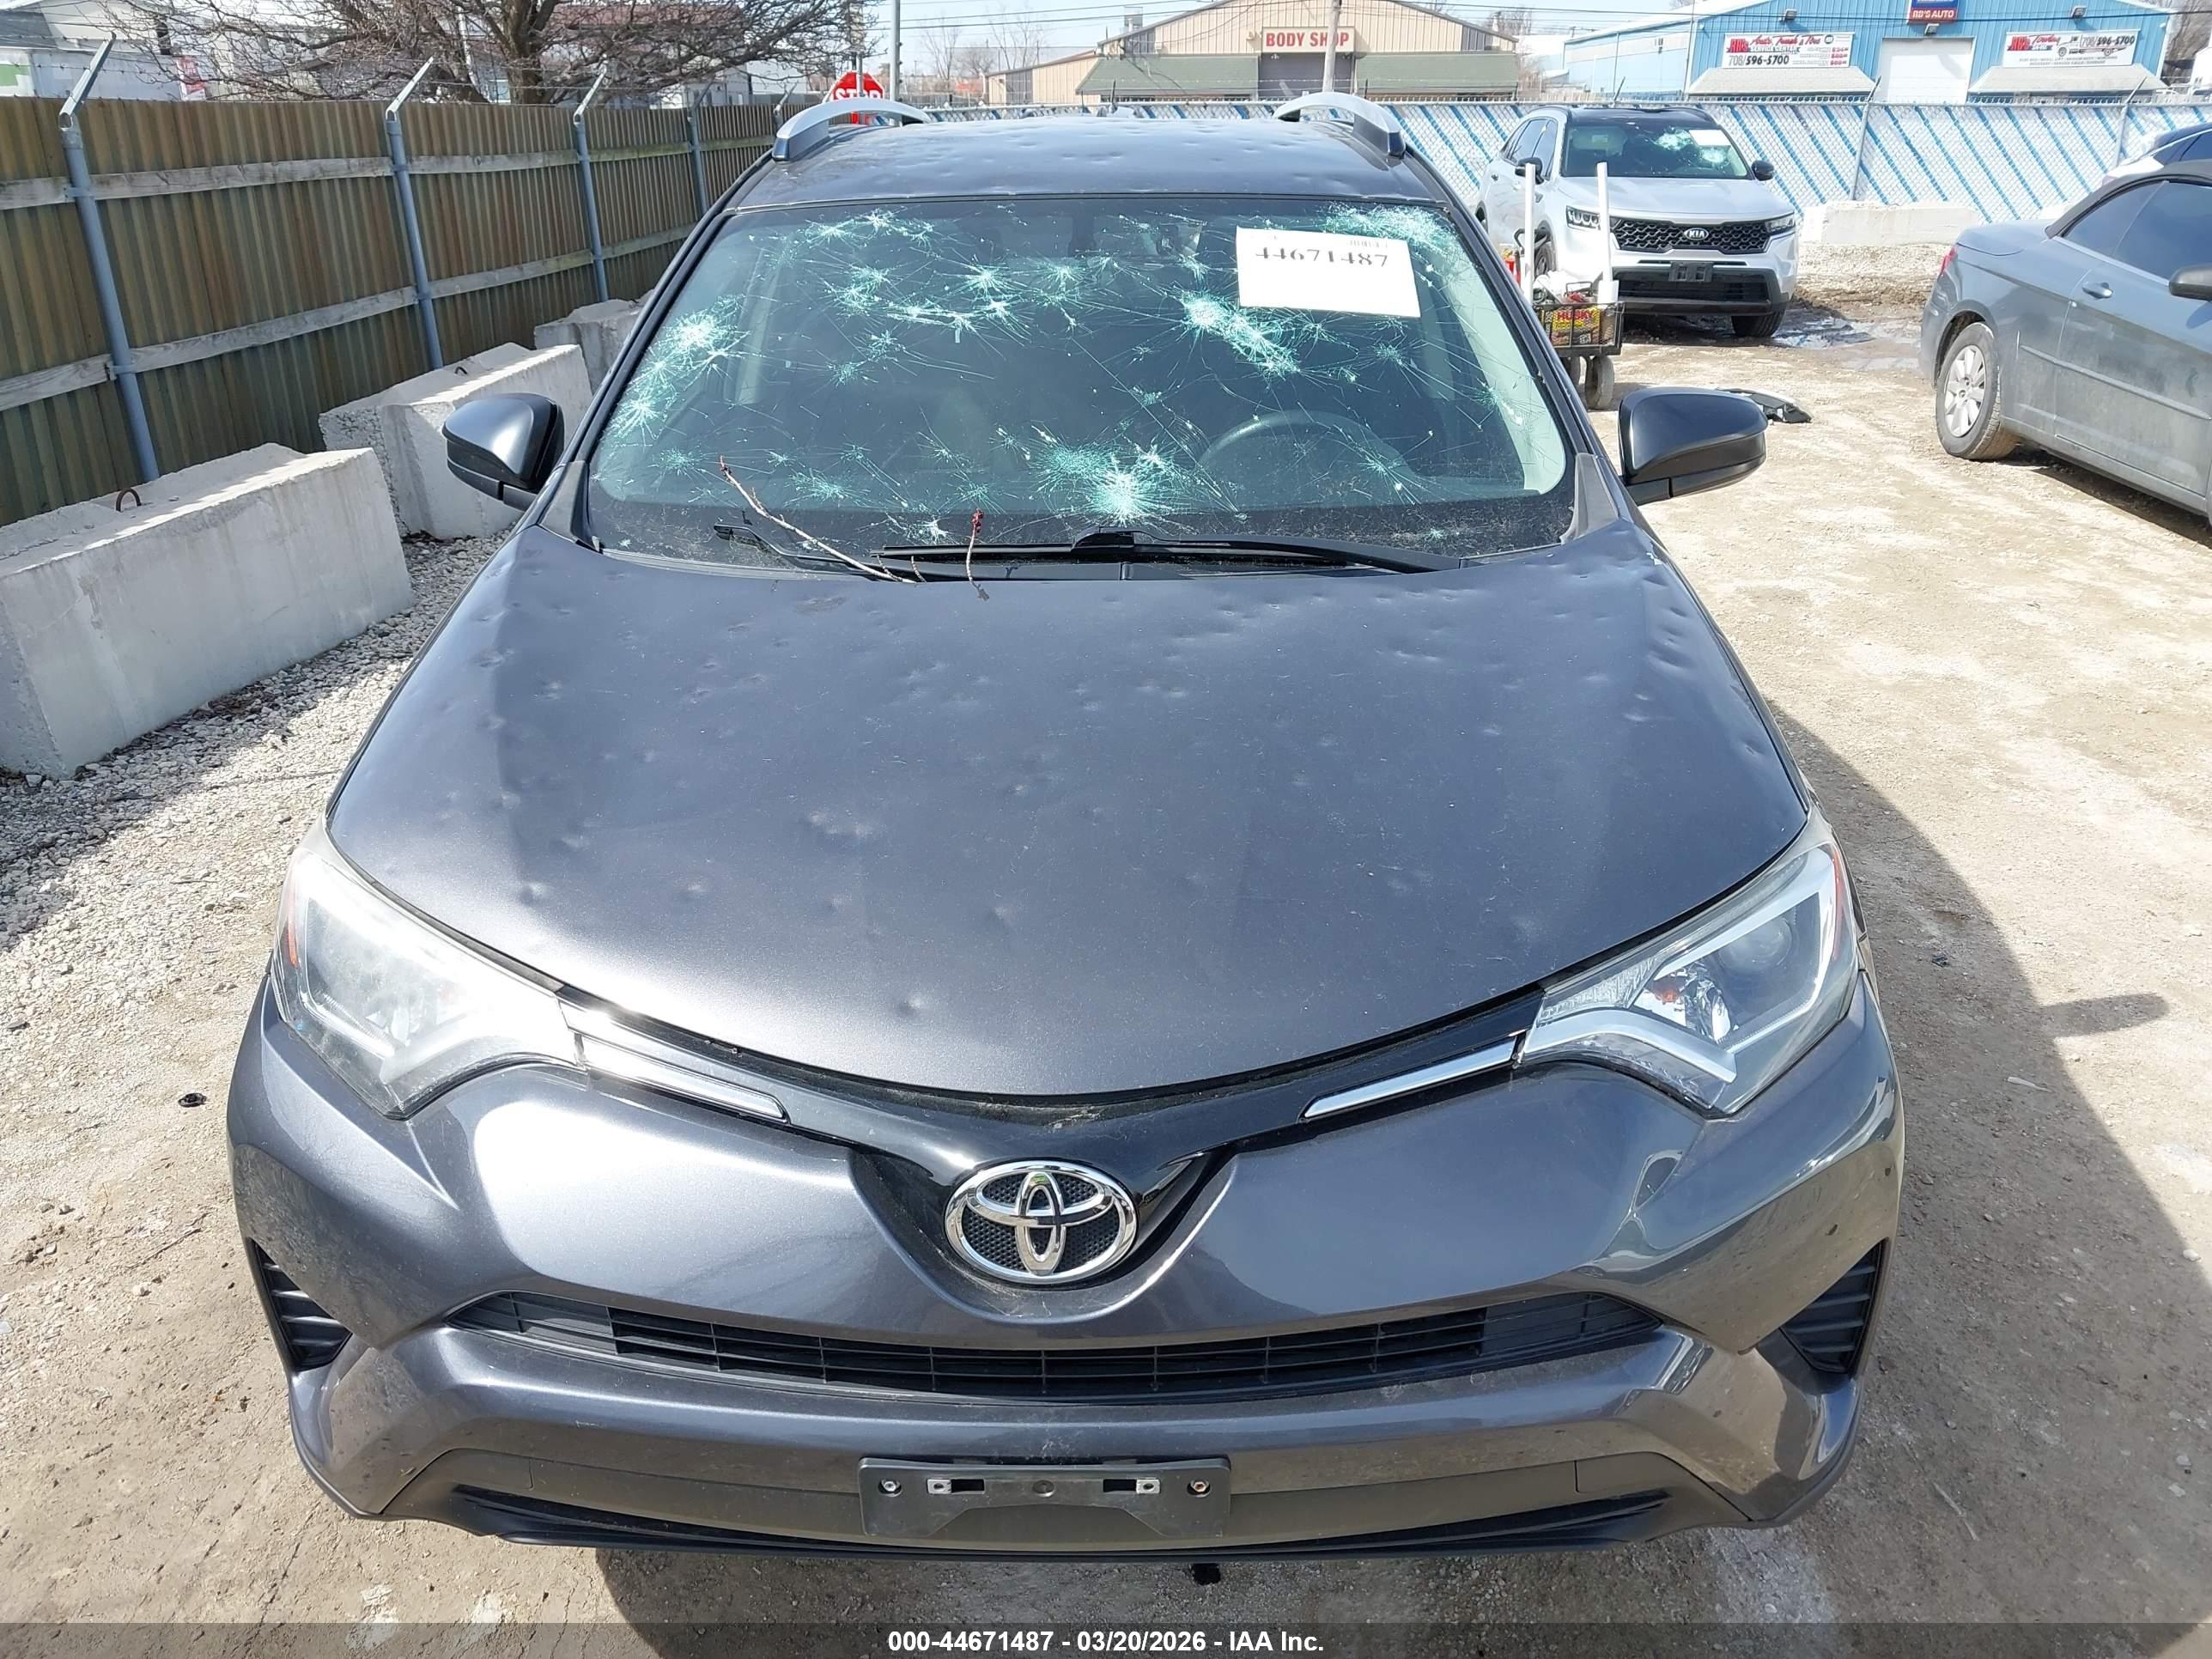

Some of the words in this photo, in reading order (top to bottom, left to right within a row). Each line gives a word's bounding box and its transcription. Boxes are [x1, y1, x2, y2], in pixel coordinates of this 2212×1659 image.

[1931, 9, 1954, 19] AUTO
[1266, 32, 1304, 47] BODY
[1729, 54, 1790, 66] 708/596-5700
[835, 88, 882, 100] STP
[1688, 229, 1705, 239] KIA
[1255, 246, 1388, 267] 44671487
